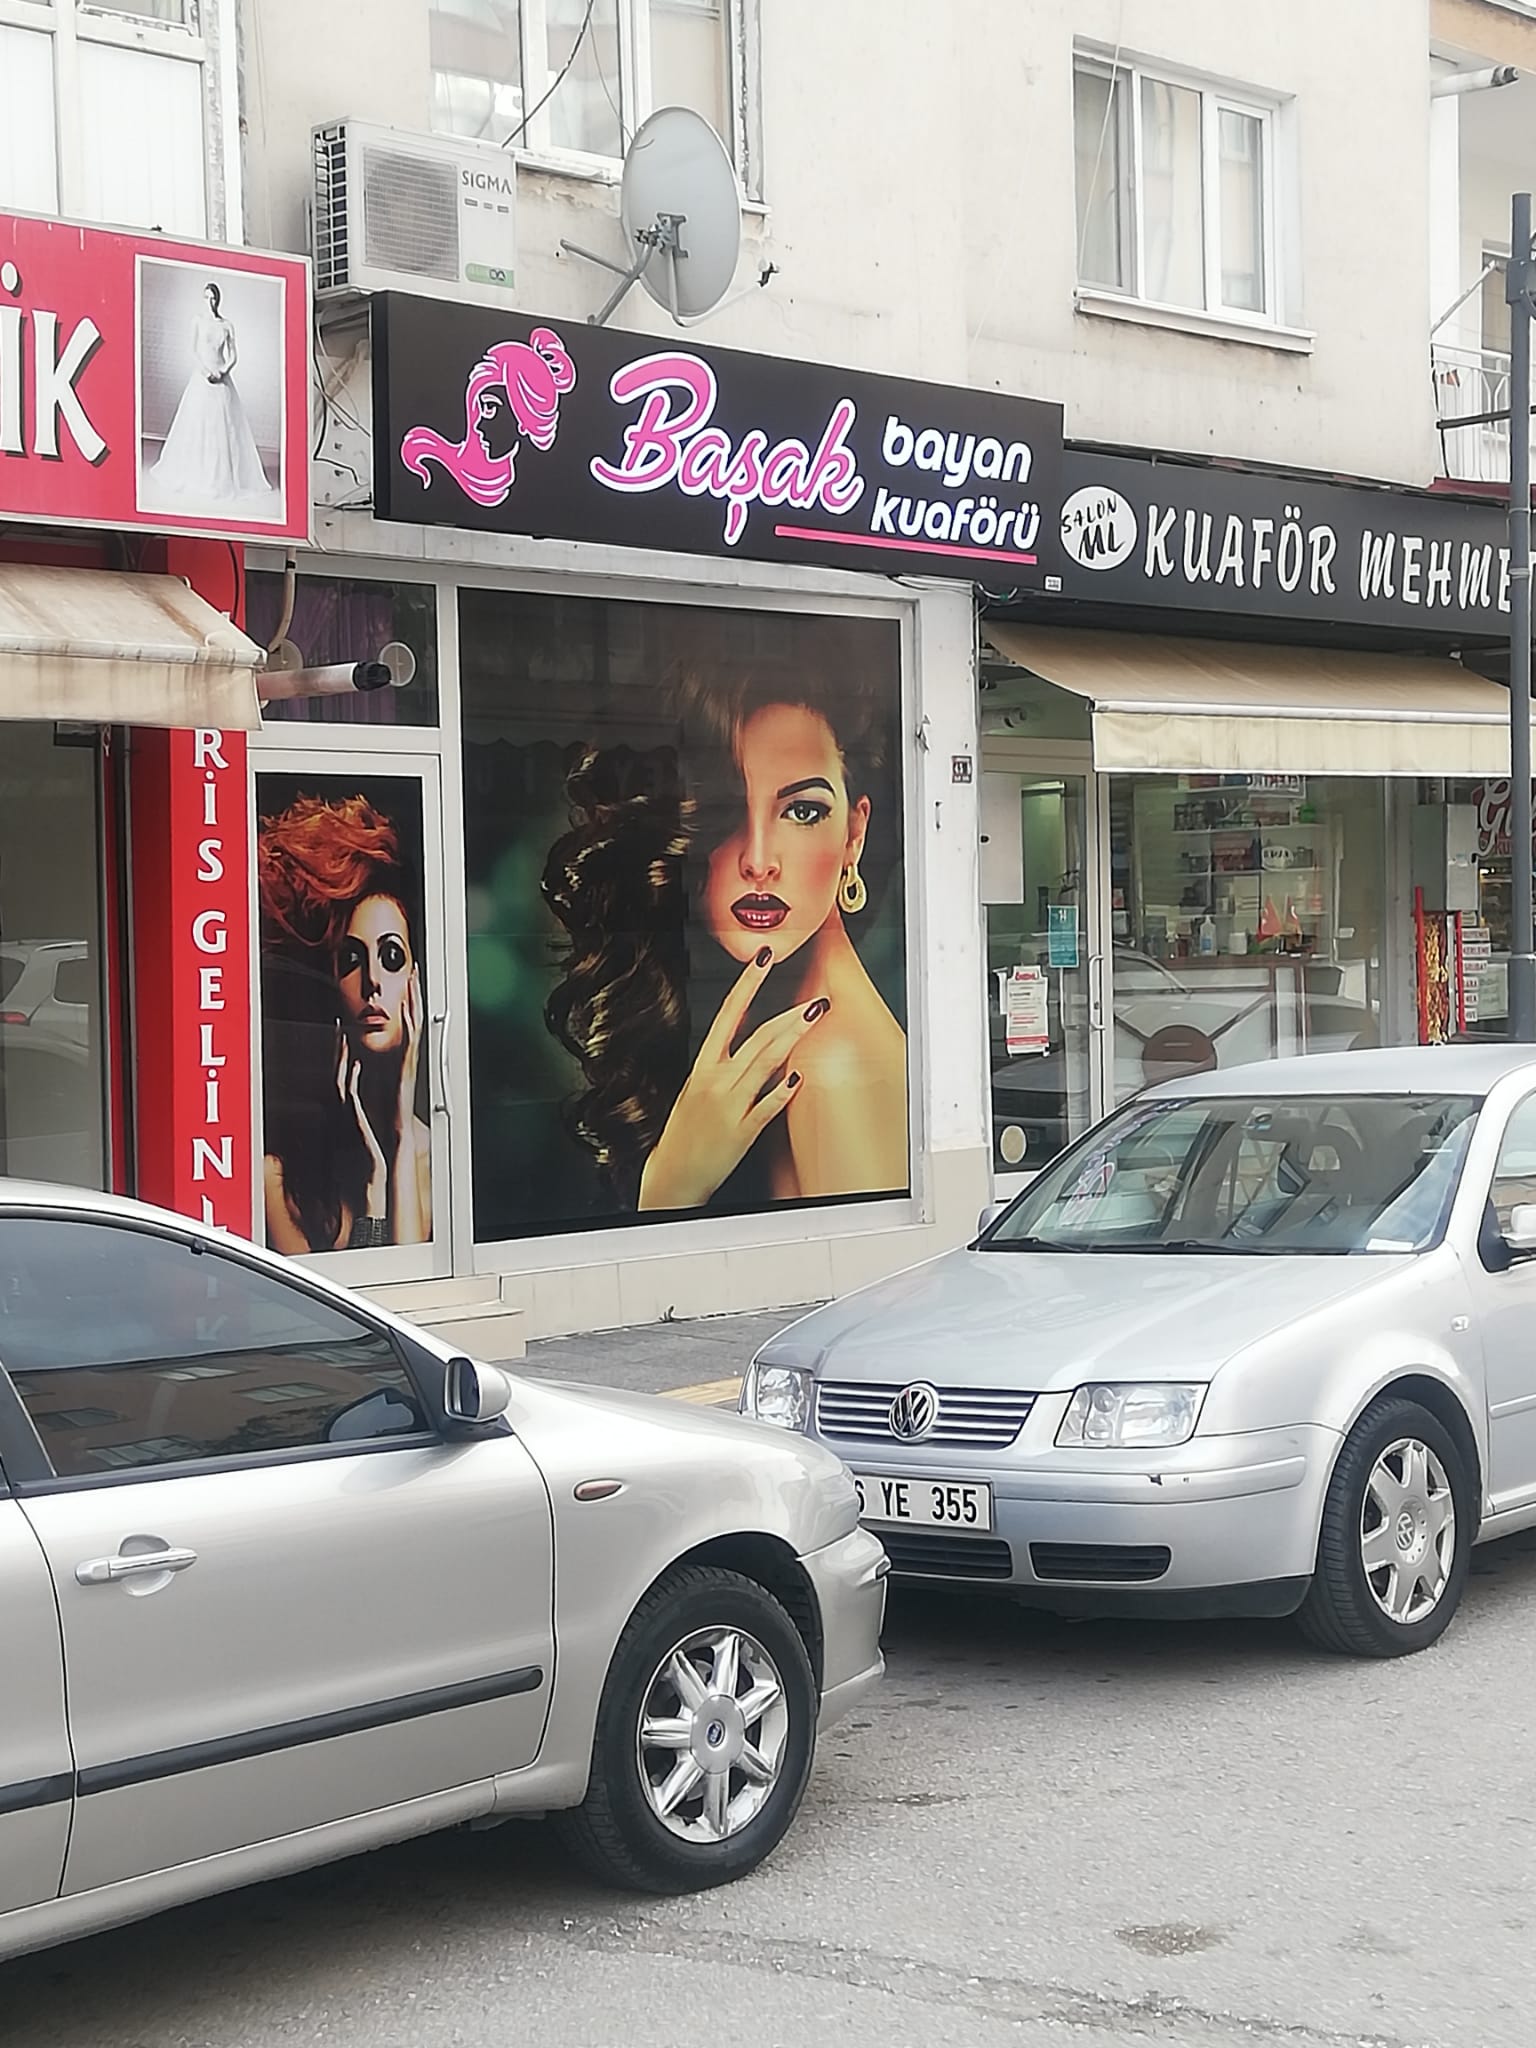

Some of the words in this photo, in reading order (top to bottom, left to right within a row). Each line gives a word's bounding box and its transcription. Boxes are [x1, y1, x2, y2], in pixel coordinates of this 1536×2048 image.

[462, 170, 512, 195] SIGMA
[590, 351, 865, 545] Başak
[882, 415, 1033, 487] bayan
[870, 487, 1041, 550] kuaförü
[1061, 494, 1117, 534] SALON
[1078, 521, 1126, 560] ML
[1144, 503, 1337, 595] KUAFÖR
[191, 910, 233, 1240] GELİNL
[881, 1481, 910, 1517] YE
[931, 1486, 977, 1523] 355
